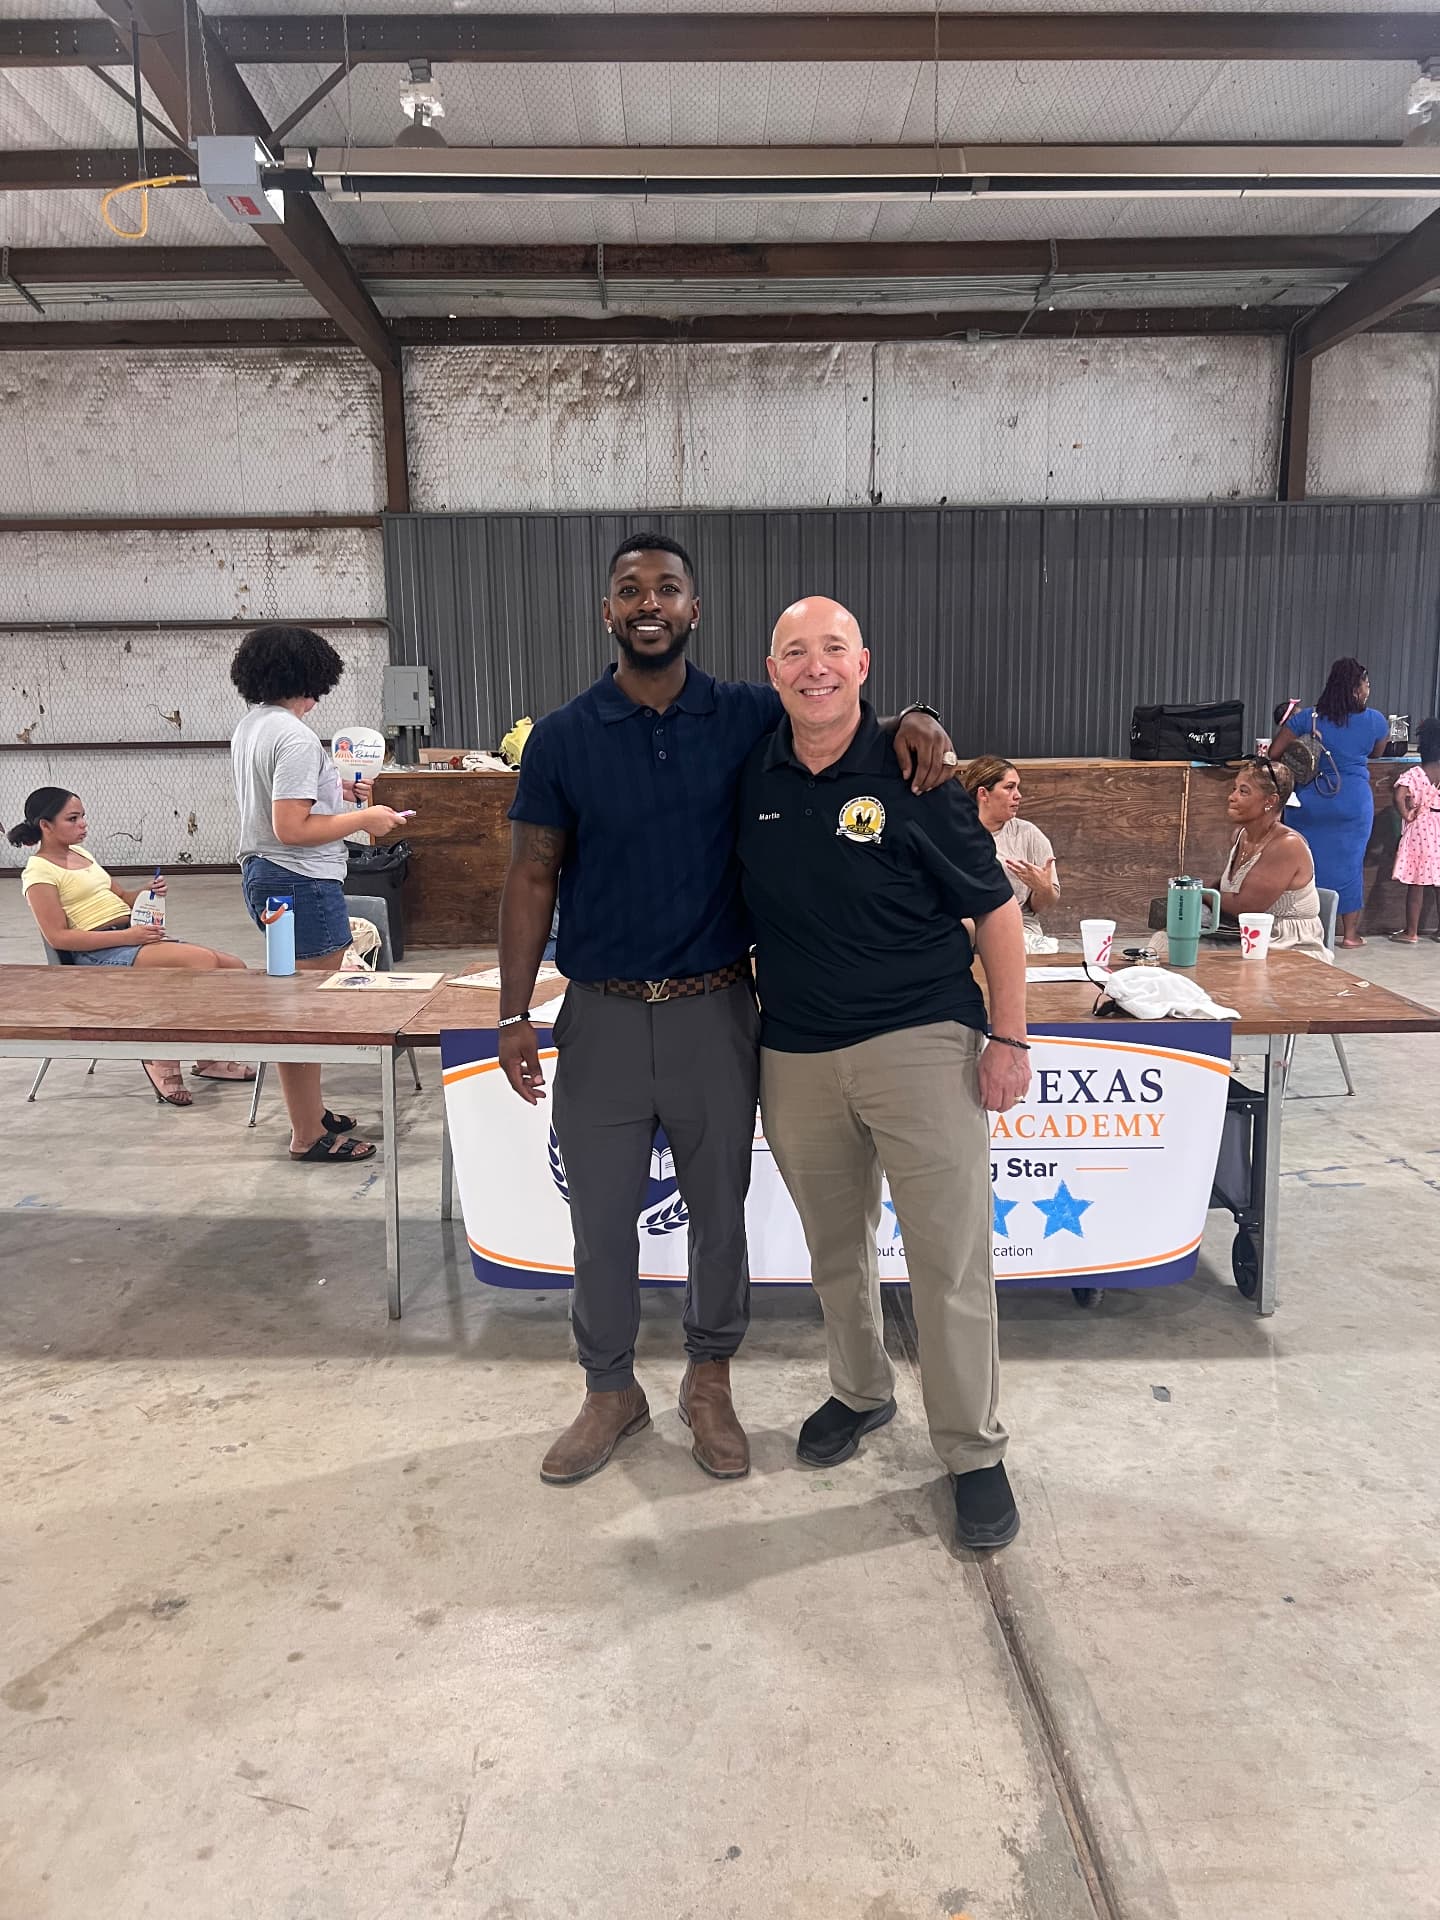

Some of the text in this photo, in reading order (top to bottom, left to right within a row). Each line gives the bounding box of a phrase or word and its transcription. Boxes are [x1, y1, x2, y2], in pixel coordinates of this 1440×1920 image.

[758, 811, 780, 821] Martin
[1019, 1068, 1164, 1104] EXAS
[991, 1113, 1169, 1138] ACADEMY
[1007, 1157, 1058, 1178] Star
[993, 1245, 1033, 1257] cation
